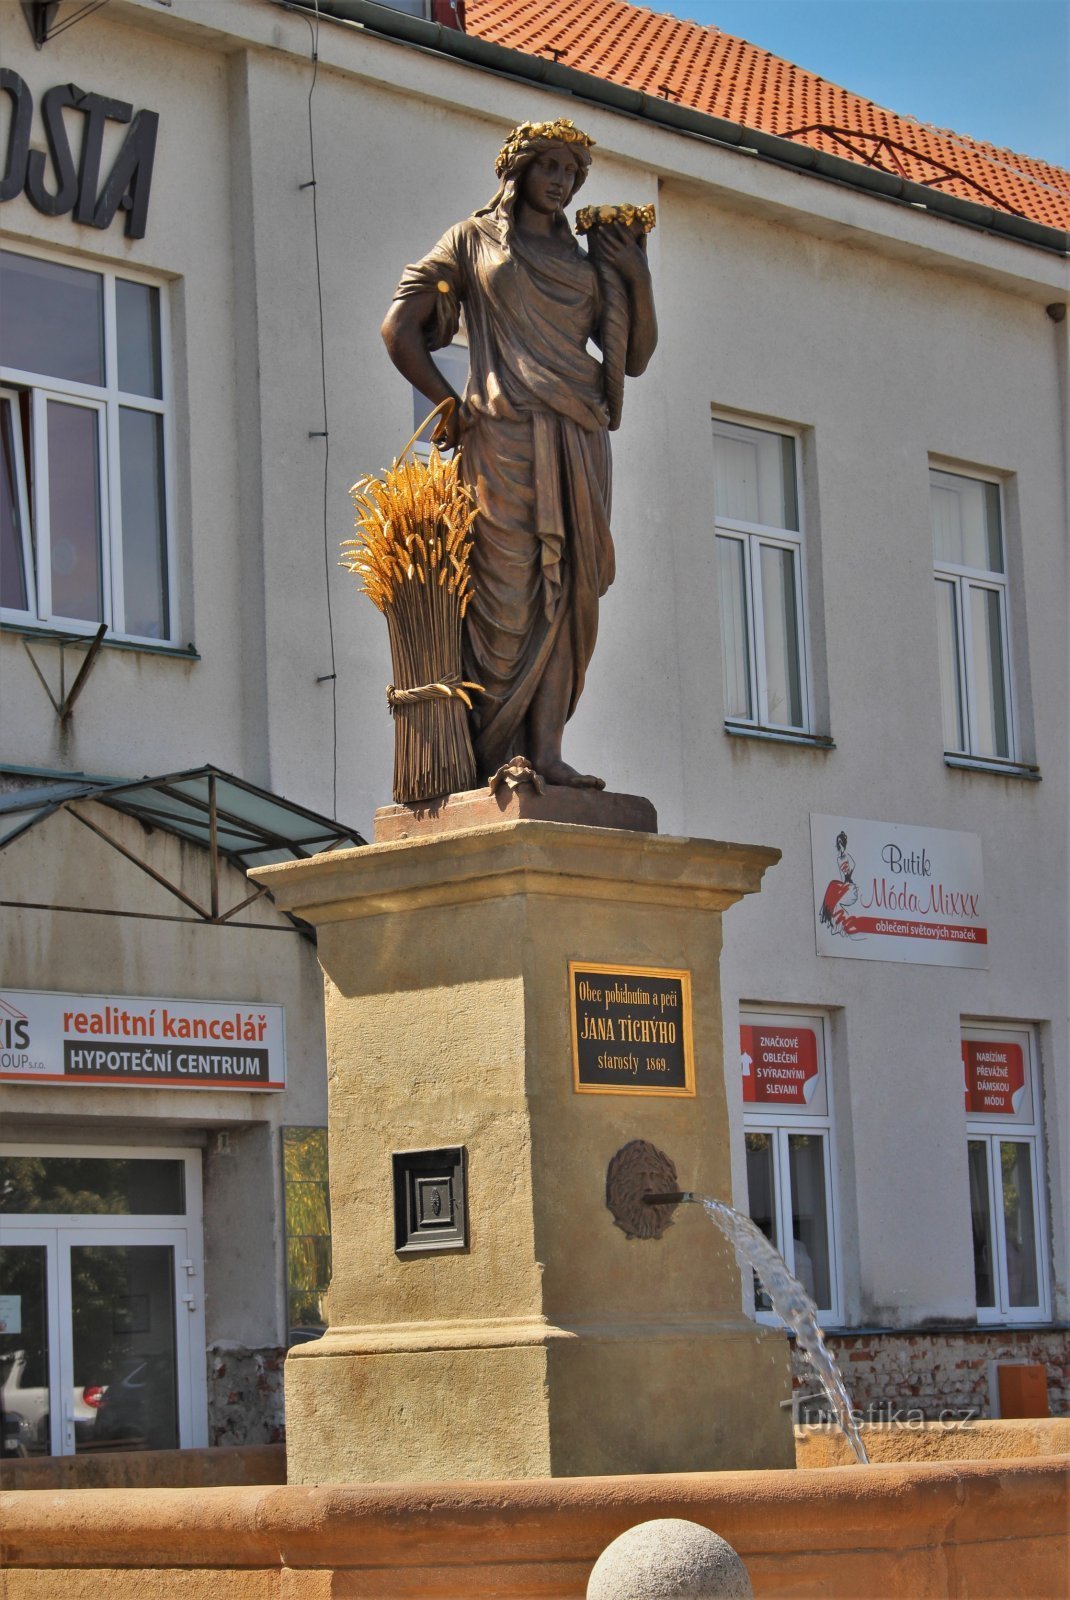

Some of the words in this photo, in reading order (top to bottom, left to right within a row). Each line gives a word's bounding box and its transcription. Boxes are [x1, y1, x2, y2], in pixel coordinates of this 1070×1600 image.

[881, 843, 932, 877] Butik
[875, 921, 909, 934] oblečení
[910, 924, 949, 940] světových
[950, 927, 976, 941] značek
[652, 993, 659, 1006] a
[63, 1006, 155, 1037] realitní
[162, 1009, 268, 1042] kancelář
[581, 1012, 615, 1041] JANA
[0, 1019, 31, 1050] IS
[760, 1035, 799, 1049] ZNAČKOVÉ
[0, 1053, 29, 1069] OUP
[70, 1049, 172, 1073] HYPOTEČNÍ
[176, 1054, 261, 1076] CENTRUM
[597, 1051, 639, 1075] starosty
[762, 1051, 798, 1064] OBLEČENÍ
[976, 1050, 1007, 1063] NABÍZÍME
[756, 1067, 763, 1078] S
[763, 1066, 806, 1080] VÝRAZNÝMI
[766, 1083, 798, 1095] SLEVAMI
[977, 1079, 1010, 1092] DÁMSKOU
[984, 1095, 1005, 1106] MÓDU
